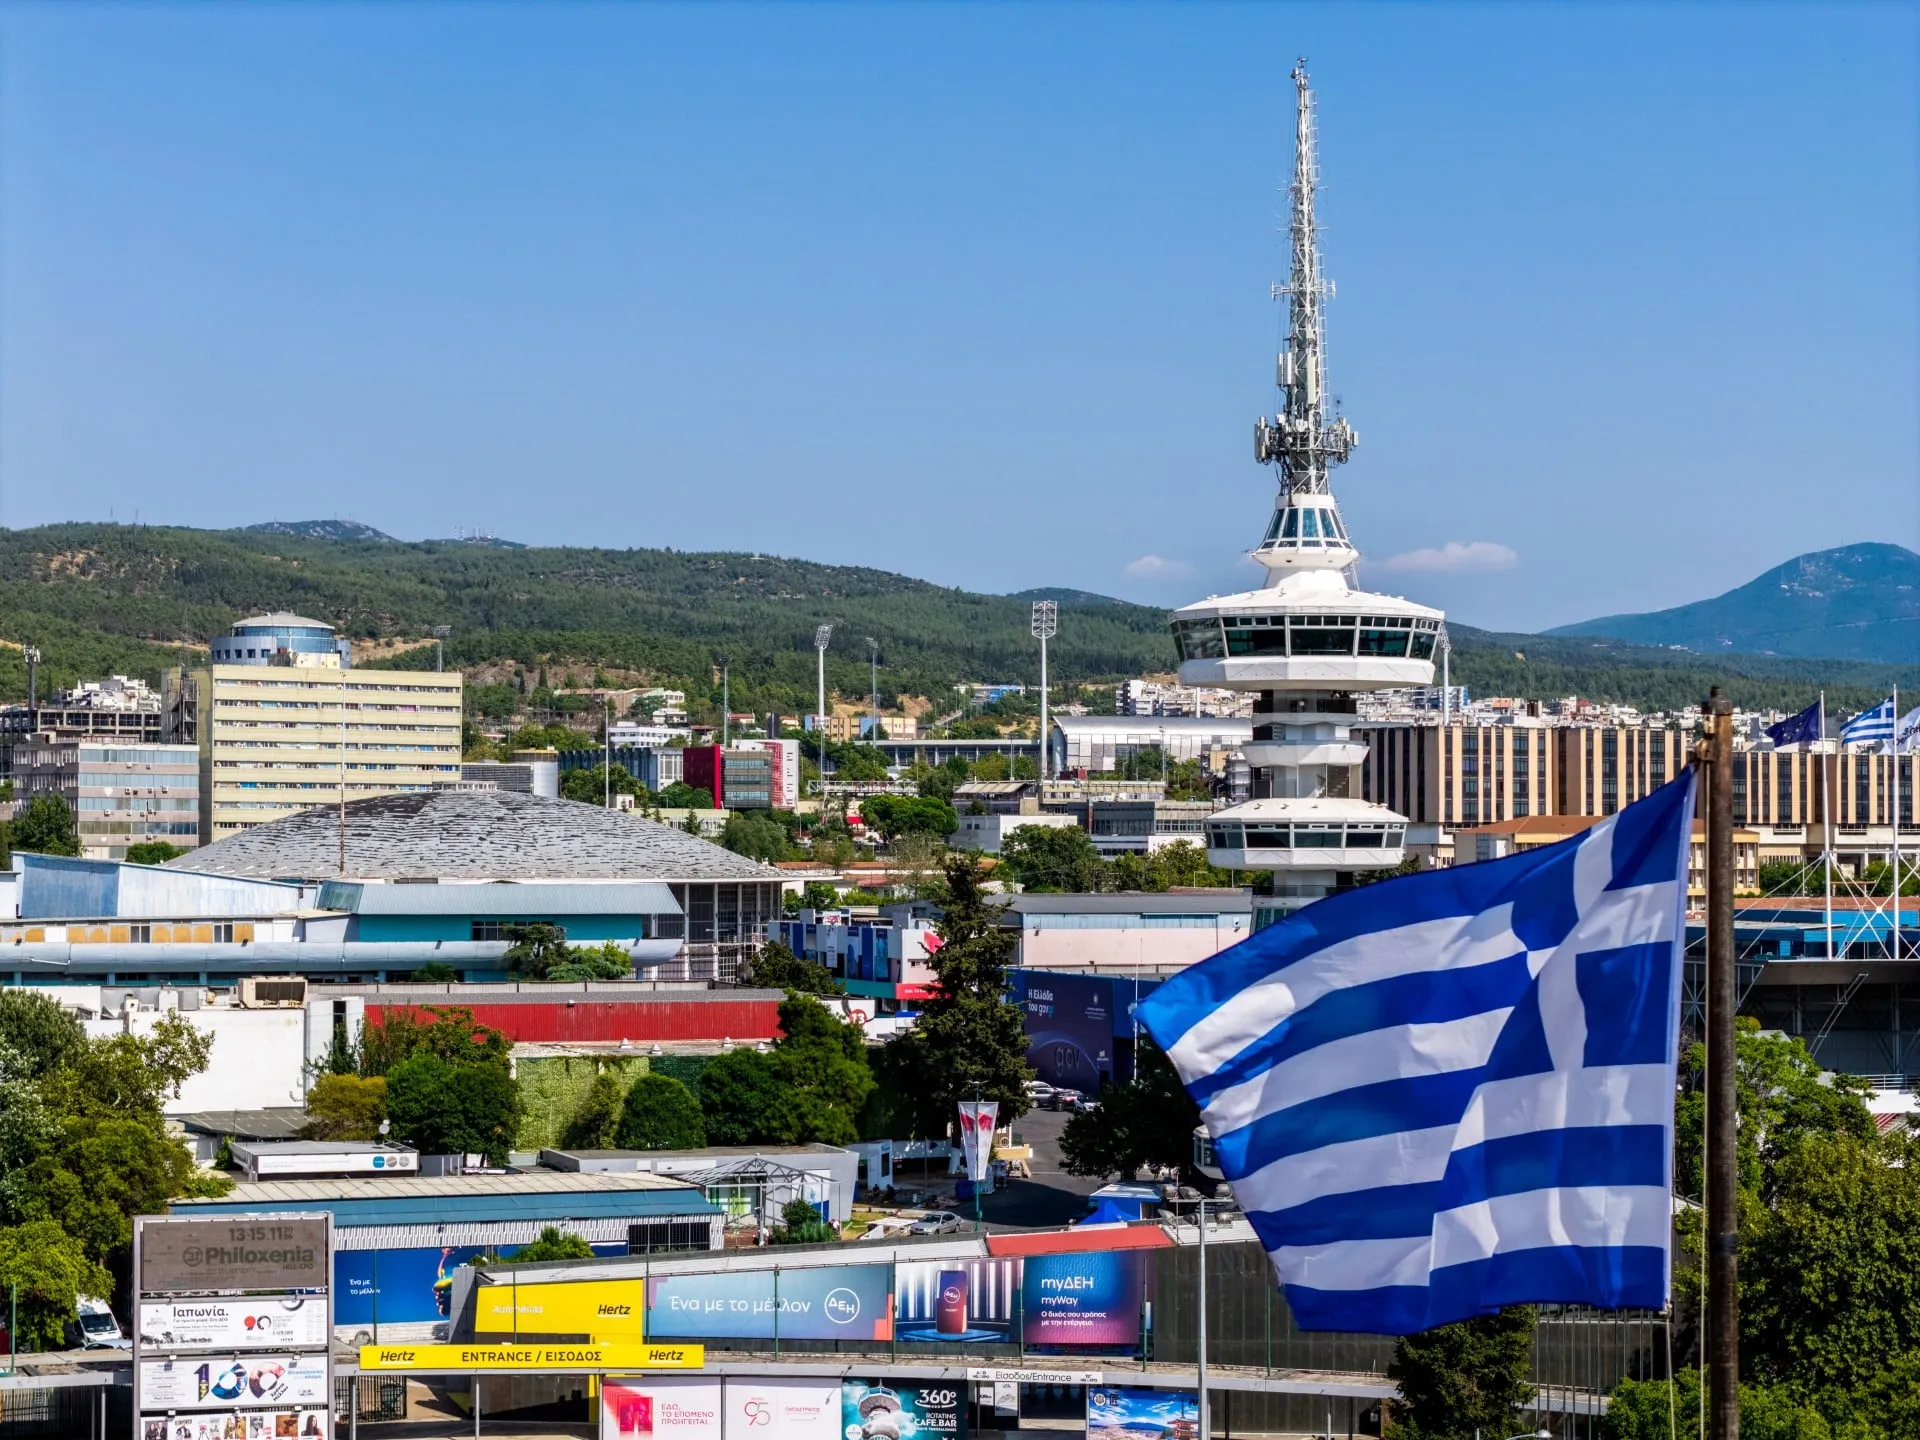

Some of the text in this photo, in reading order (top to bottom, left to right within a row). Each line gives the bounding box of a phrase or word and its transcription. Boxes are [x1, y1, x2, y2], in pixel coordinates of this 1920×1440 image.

[1056, 1046, 1080, 1077] gov
[205, 1246, 314, 1265] Philoxenia
[1041, 1276, 1094, 1292] myΔΕΗ
[669, 1296, 700, 1310] Ένα
[705, 1299, 724, 1314] με
[729, 1299, 748, 1312] το
[828, 1297, 855, 1314] ΔΕΗ
[1041, 1296, 1078, 1306] myWay
[173, 1306, 229, 1318] Ιαπωνία.
[598, 1304, 631, 1315] Hertz
[380, 1351, 415, 1362] Hertz
[462, 1350, 602, 1363] ENTRANCE / ΕΙΣΟΔΟΣ
[649, 1350, 684, 1361] Hertz
[914, 1419, 957, 1427] CAFE.BAR
